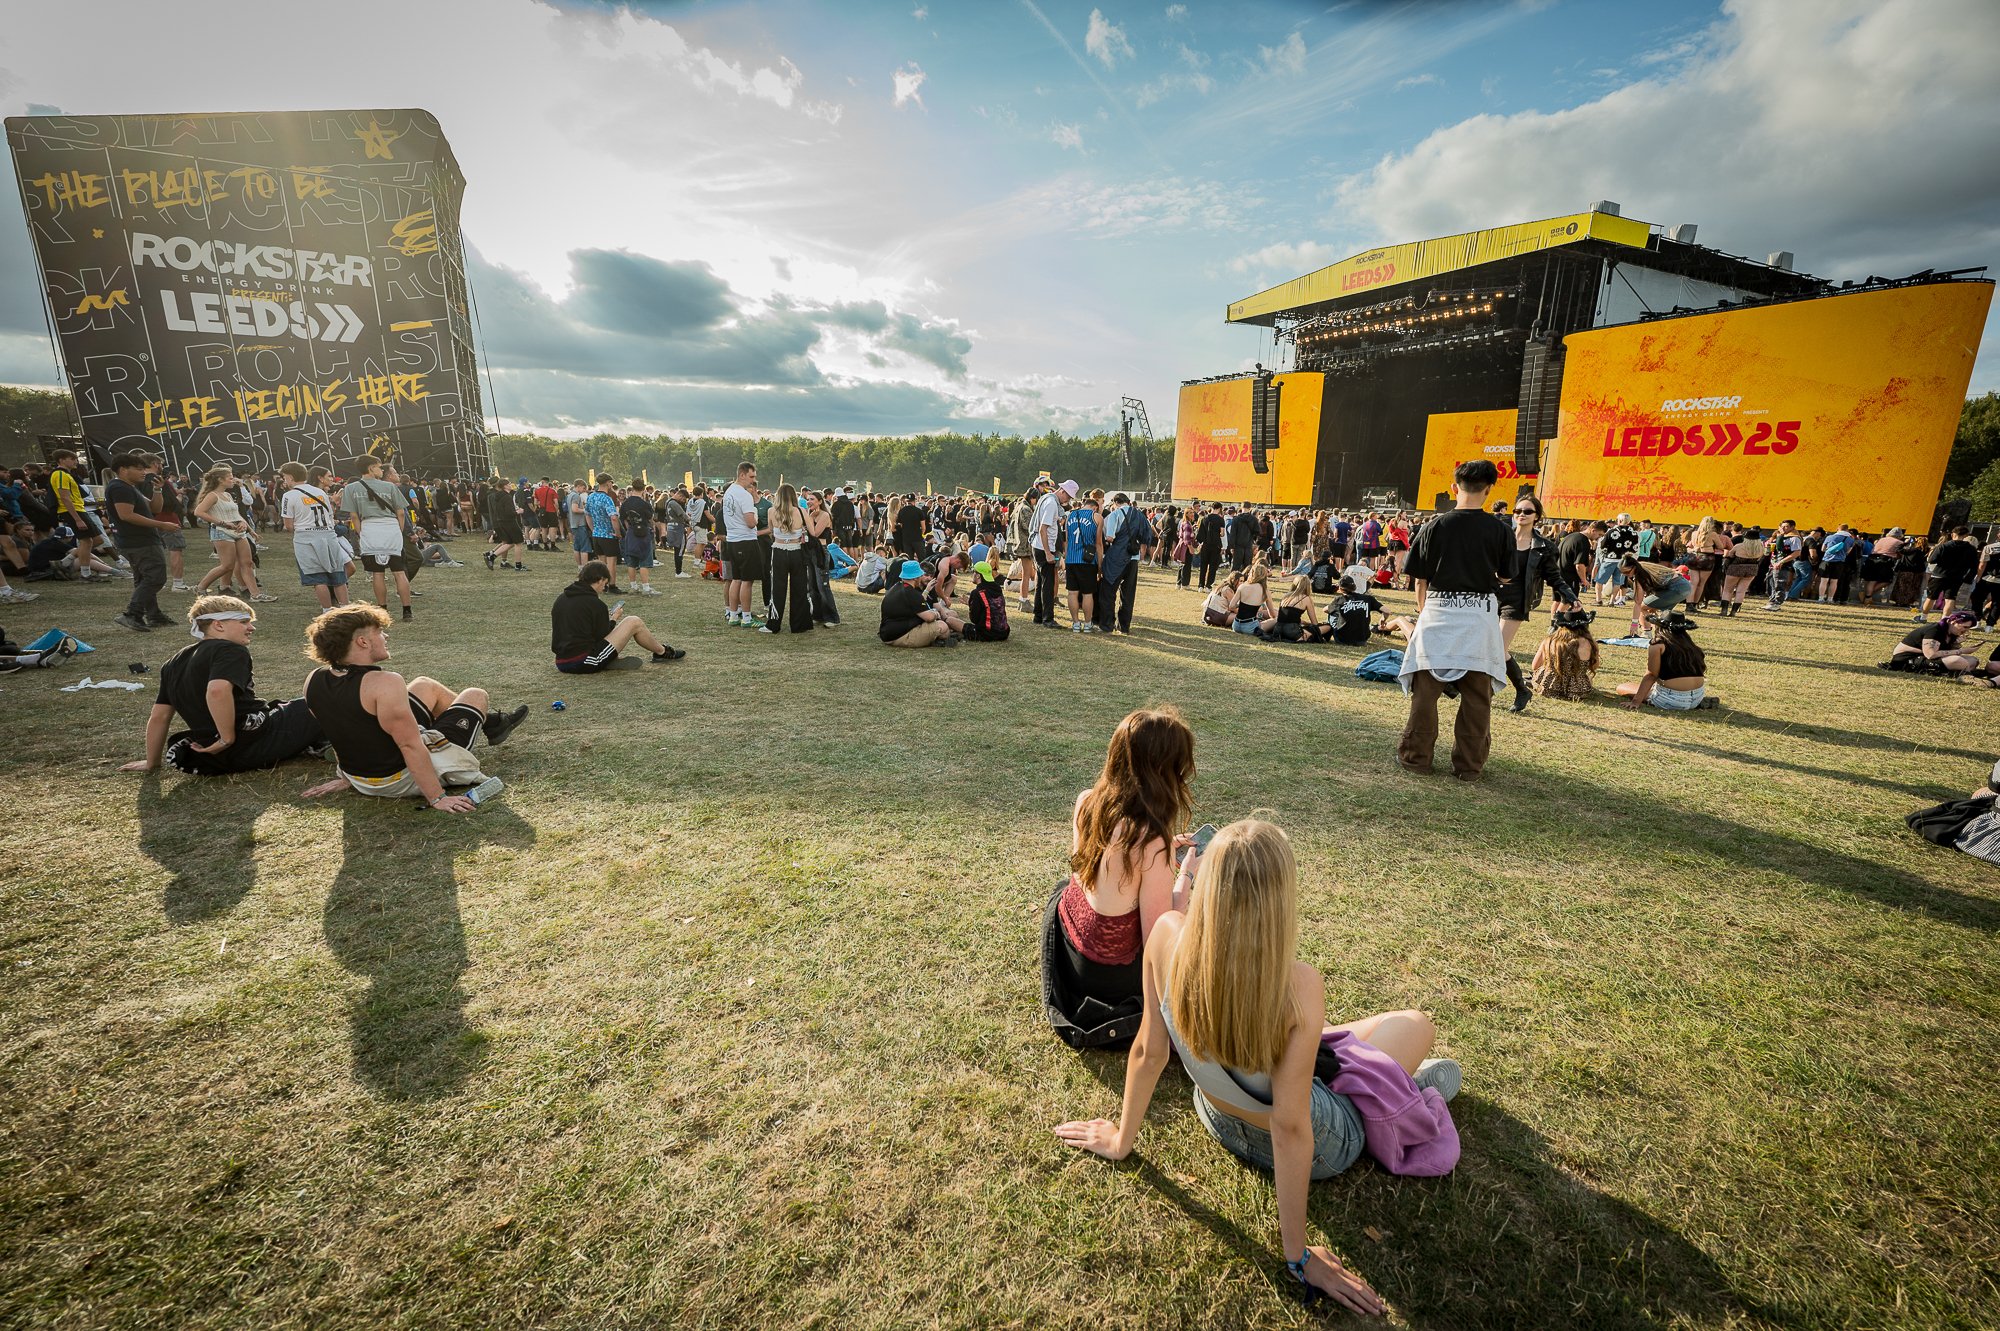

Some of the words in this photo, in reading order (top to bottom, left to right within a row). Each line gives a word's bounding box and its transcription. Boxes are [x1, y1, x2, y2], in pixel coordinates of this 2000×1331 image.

[33, 170, 110, 214] THE
[229, 166, 277, 201] TO
[288, 165, 337, 200] BE
[132, 232, 372, 287] ROCKSTAR
[1356, 252, 1385, 265] ROCKSTAR
[181, 274, 262, 289] ENERGY
[275, 283, 335, 296] DRINK
[1342, 265, 1382, 291] LEEDS
[160, 290, 320, 339] LEEDS
[144, 397, 225, 435] LIFE
[234, 378, 348, 424] BEGINS
[356, 373, 431, 409] HERE
[1661, 395, 1742, 412] ROCKSTAR
[1602, 424, 1706, 457] LEEDS
[1742, 421, 1801, 455] 25
[1192, 443, 1227, 462] LEEDS
[1073, 527, 1081, 544] 1
